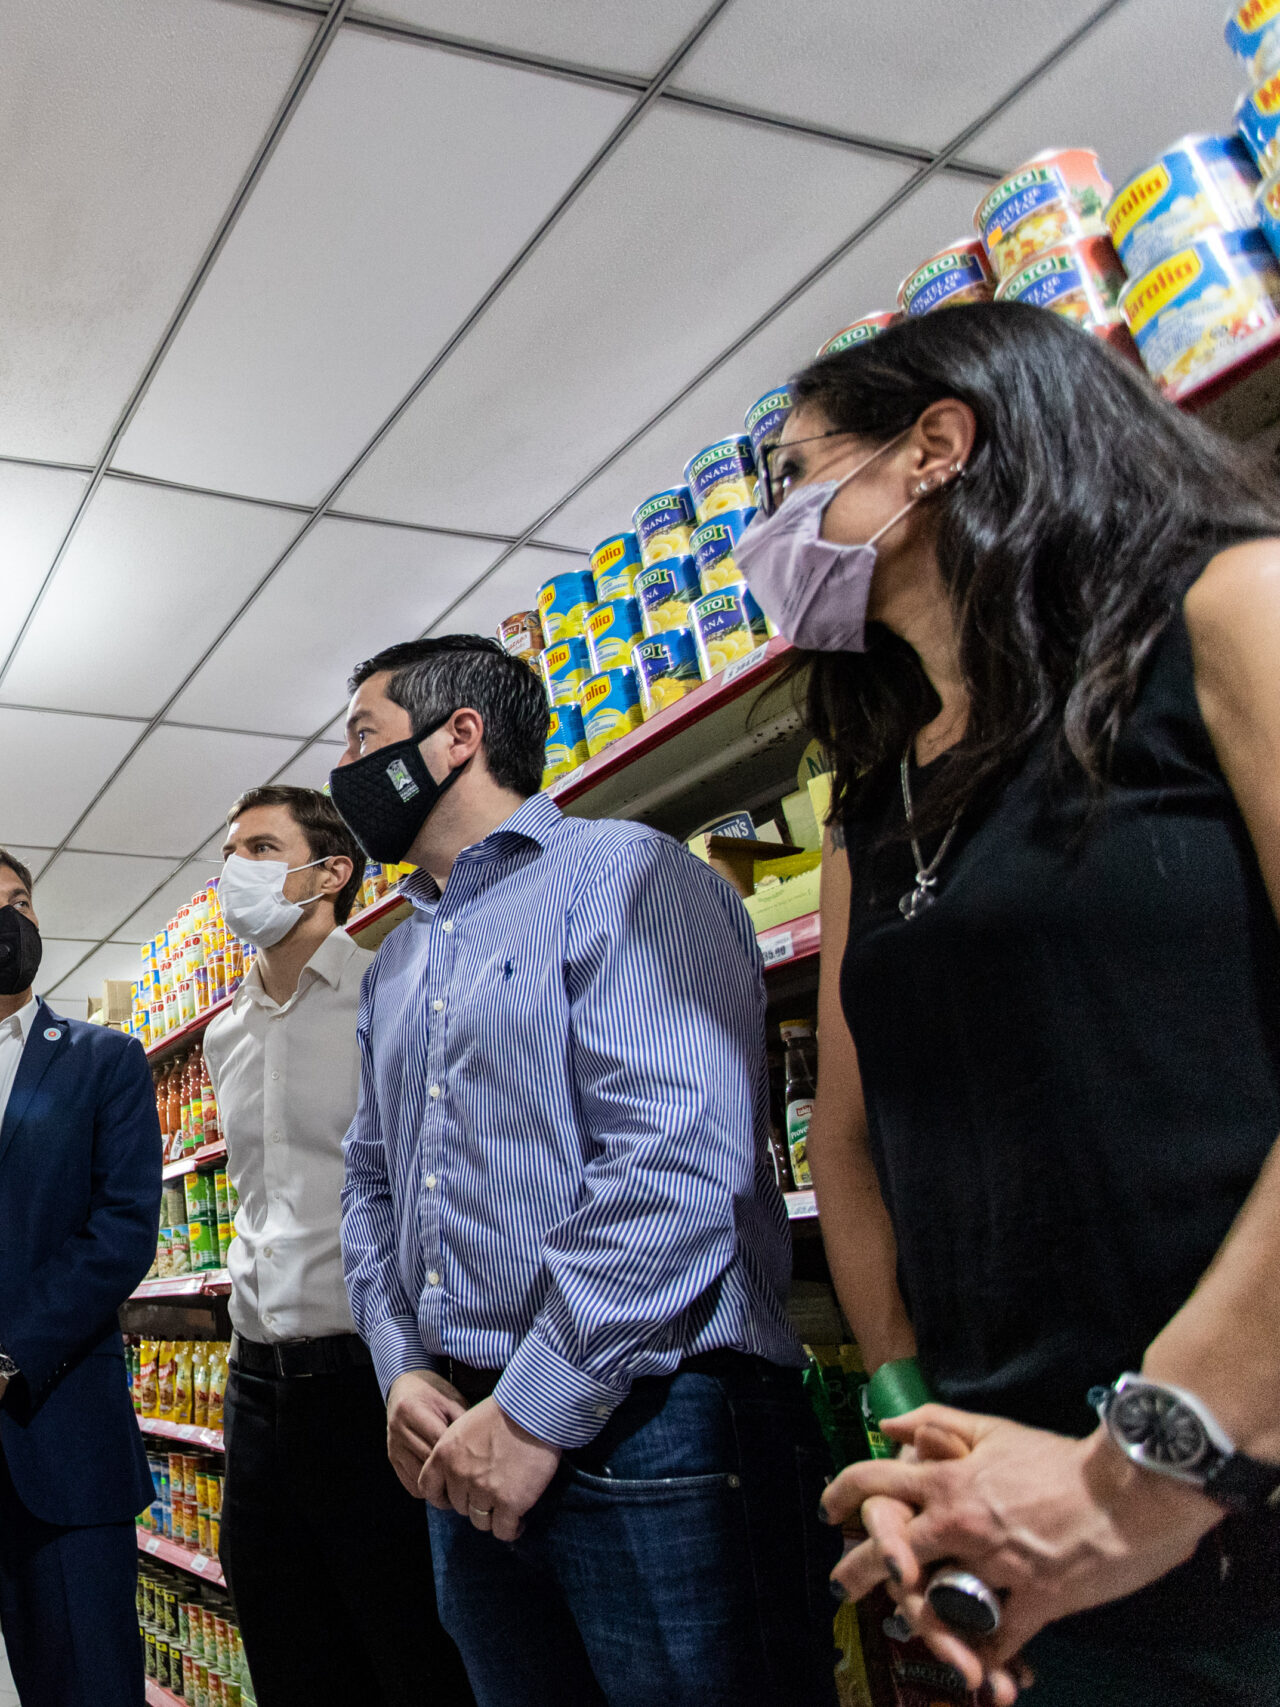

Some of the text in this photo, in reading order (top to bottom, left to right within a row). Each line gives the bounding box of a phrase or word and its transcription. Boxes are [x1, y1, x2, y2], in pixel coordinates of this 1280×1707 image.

[981, 173, 1033, 220] MOLTO
[1109, 177, 1162, 234] arolio
[906, 257, 954, 296] MOLTO
[1125, 261, 1192, 318] arolio
[829, 327, 867, 352] OLTO
[694, 446, 736, 474] MOLTO
[699, 460, 737, 487] ANANÁ
[697, 599, 722, 618] OLTO
